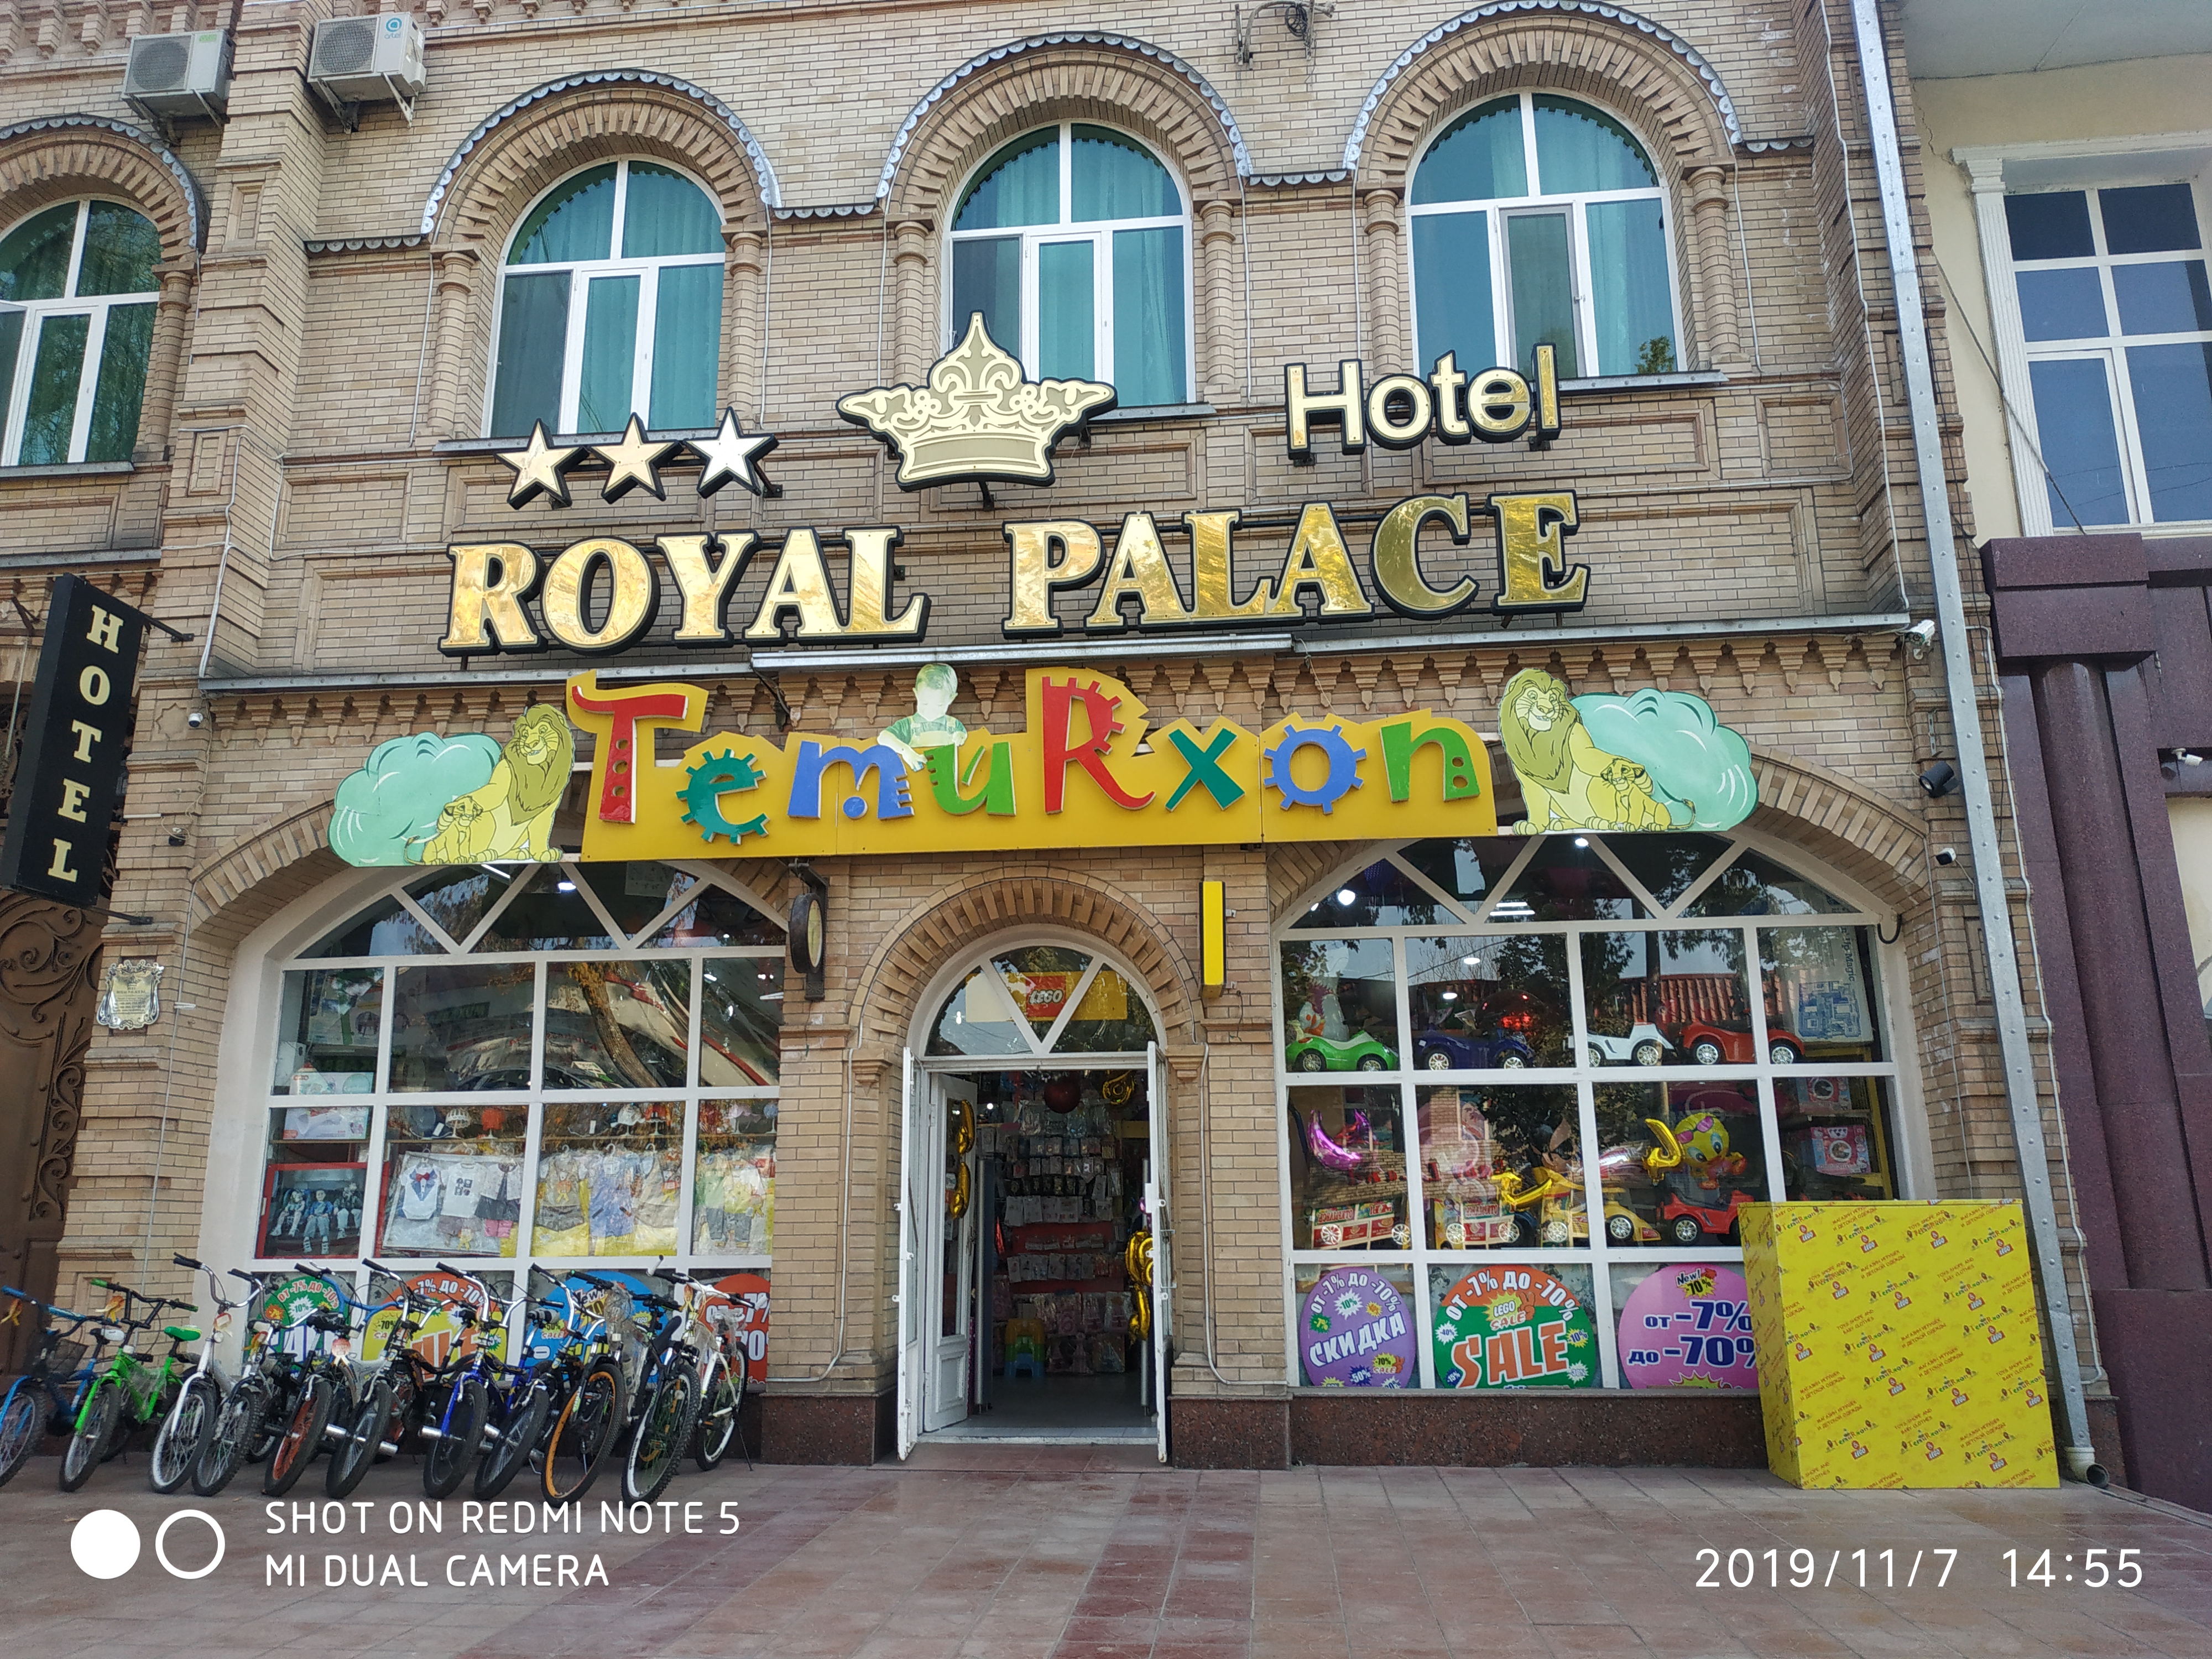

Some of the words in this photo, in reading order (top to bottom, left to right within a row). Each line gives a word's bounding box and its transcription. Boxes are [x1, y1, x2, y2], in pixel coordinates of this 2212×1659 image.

[1284, 343, 1563, 463] Hotel
[439, 524, 929, 656] ROYAL
[1001, 490, 1592, 640] PALACE
[48, 604, 124, 883] HOTEL
[1845, 952, 1855, 982] Magic
[1029, 989, 1063, 1004] LEGO
[1676, 1268, 1701, 1286] New!
[1686, 1277, 1712, 1295] -70%
[278, 1288, 290, 1302] ОТ
[308, 1281, 323, 1292] ДО
[437, 1280, 458, 1295] ДО
[1310, 1294, 1327, 1314] ОТ
[1323, 1273, 1345, 1296] -7%
[1348, 1272, 1369, 1287] ДО
[1445, 1293, 1469, 1321] ОТ
[1465, 1269, 1499, 1297] -7%
[1503, 1270, 1531, 1291] ДО
[293, 1303, 310, 1313] -10%
[1339, 1297, 1358, 1310] -10%
[1493, 1300, 1516, 1318] LEGO
[1313, 1317, 1329, 1331] -7%
[1489, 1310, 1527, 1331] SALE
[1673, 1300, 1753, 1332] -7%
[541, 1331, 565, 1339] SALE
[1309, 1311, 1407, 1368] СКИДКА
[1568, 1329, 1588, 1343] -10%
[1375, 1357, 1392, 1365] -70%
[1451, 1319, 1570, 1389] SALE
[1350, 1369, 1372, 1384] -50%
[1373, 1366, 1397, 1374] SALE
[1447, 1371, 1461, 1383] -15%
